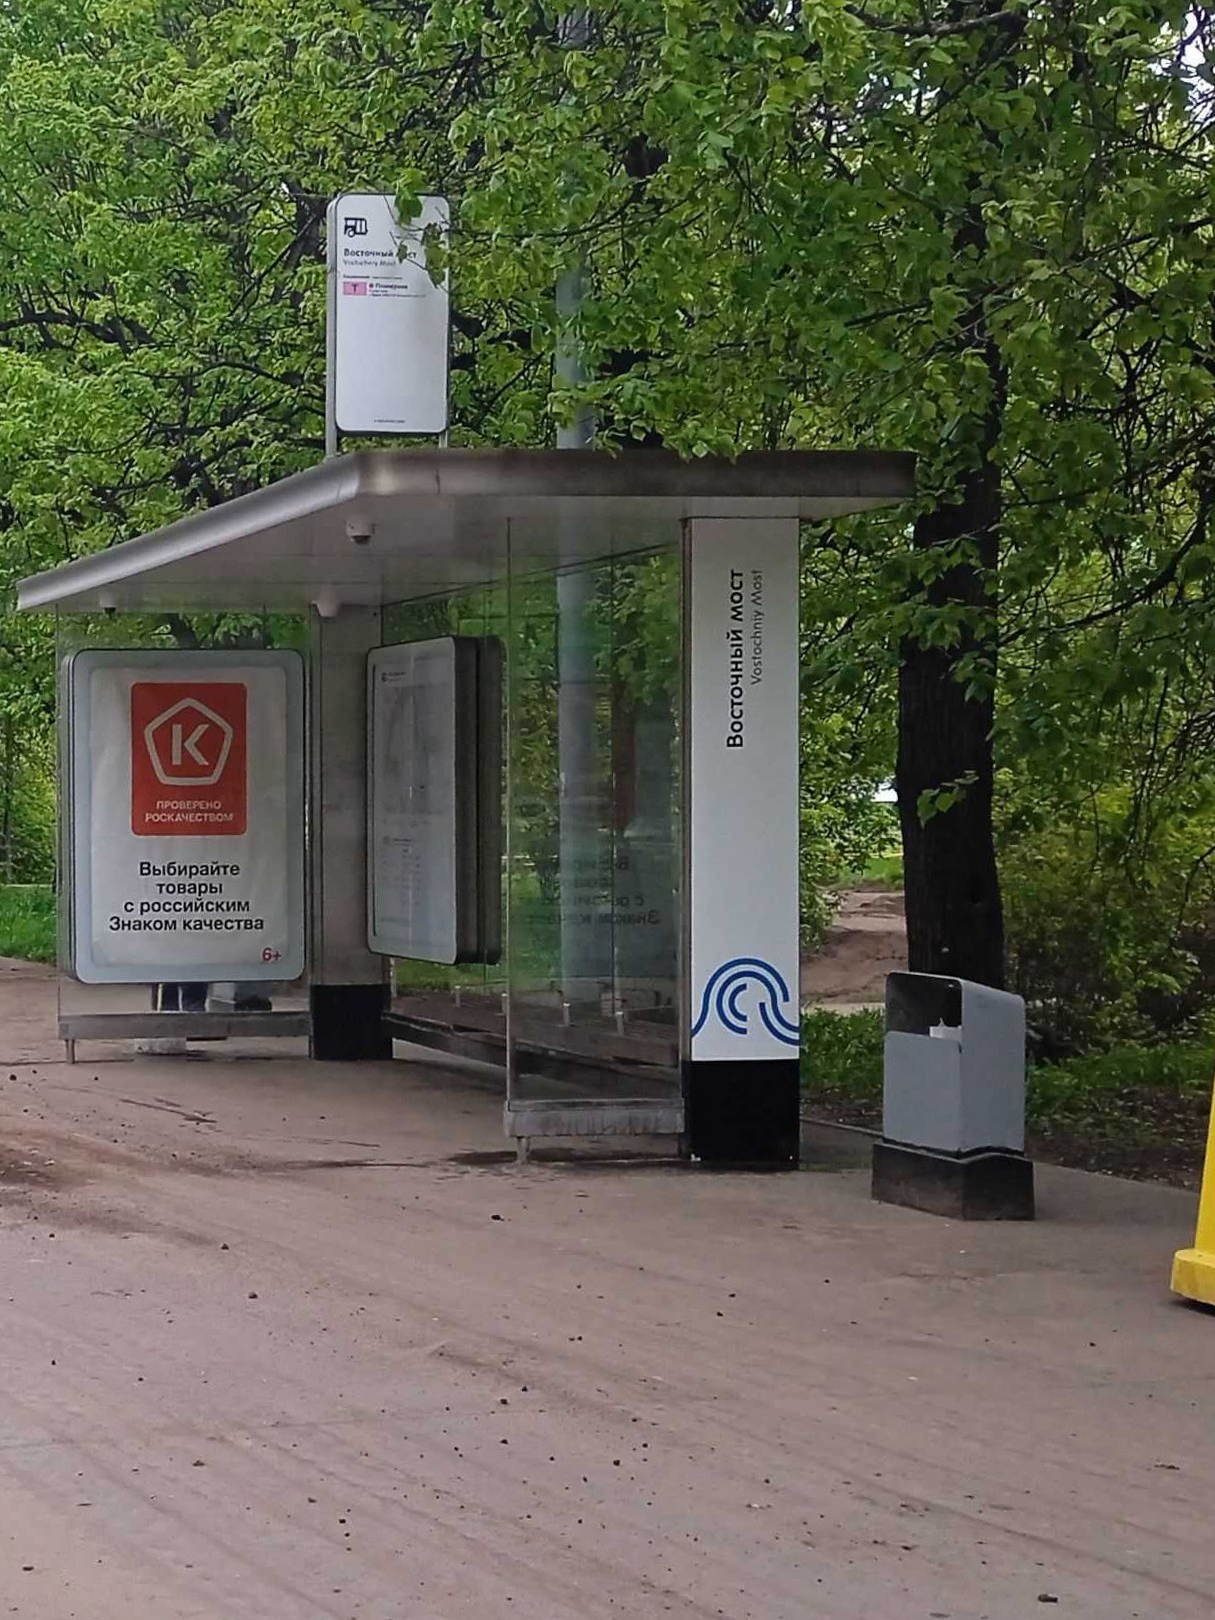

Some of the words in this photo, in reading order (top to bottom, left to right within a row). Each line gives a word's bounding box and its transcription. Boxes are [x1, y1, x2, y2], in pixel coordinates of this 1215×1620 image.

[344, 248, 394, 257] Восточный
[730, 569, 744, 622] мост
[750, 569, 763, 606] Most
[750, 610, 764, 685] Vostochniy
[726, 629, 744, 748] Восточный
[156, 800, 222, 810] ПРОВЕРЕНО
[145, 812, 234, 823] РОСКАЧЕСТВОМ
[139, 861, 241, 878] Выбирайте
[157, 882, 223, 896] товары
[124, 901, 135, 913] с
[140, 898, 250, 915] российским
[109, 916, 177, 931] Знаком
[183, 918, 265, 931] качества
[262, 947, 282, 962] 6+
